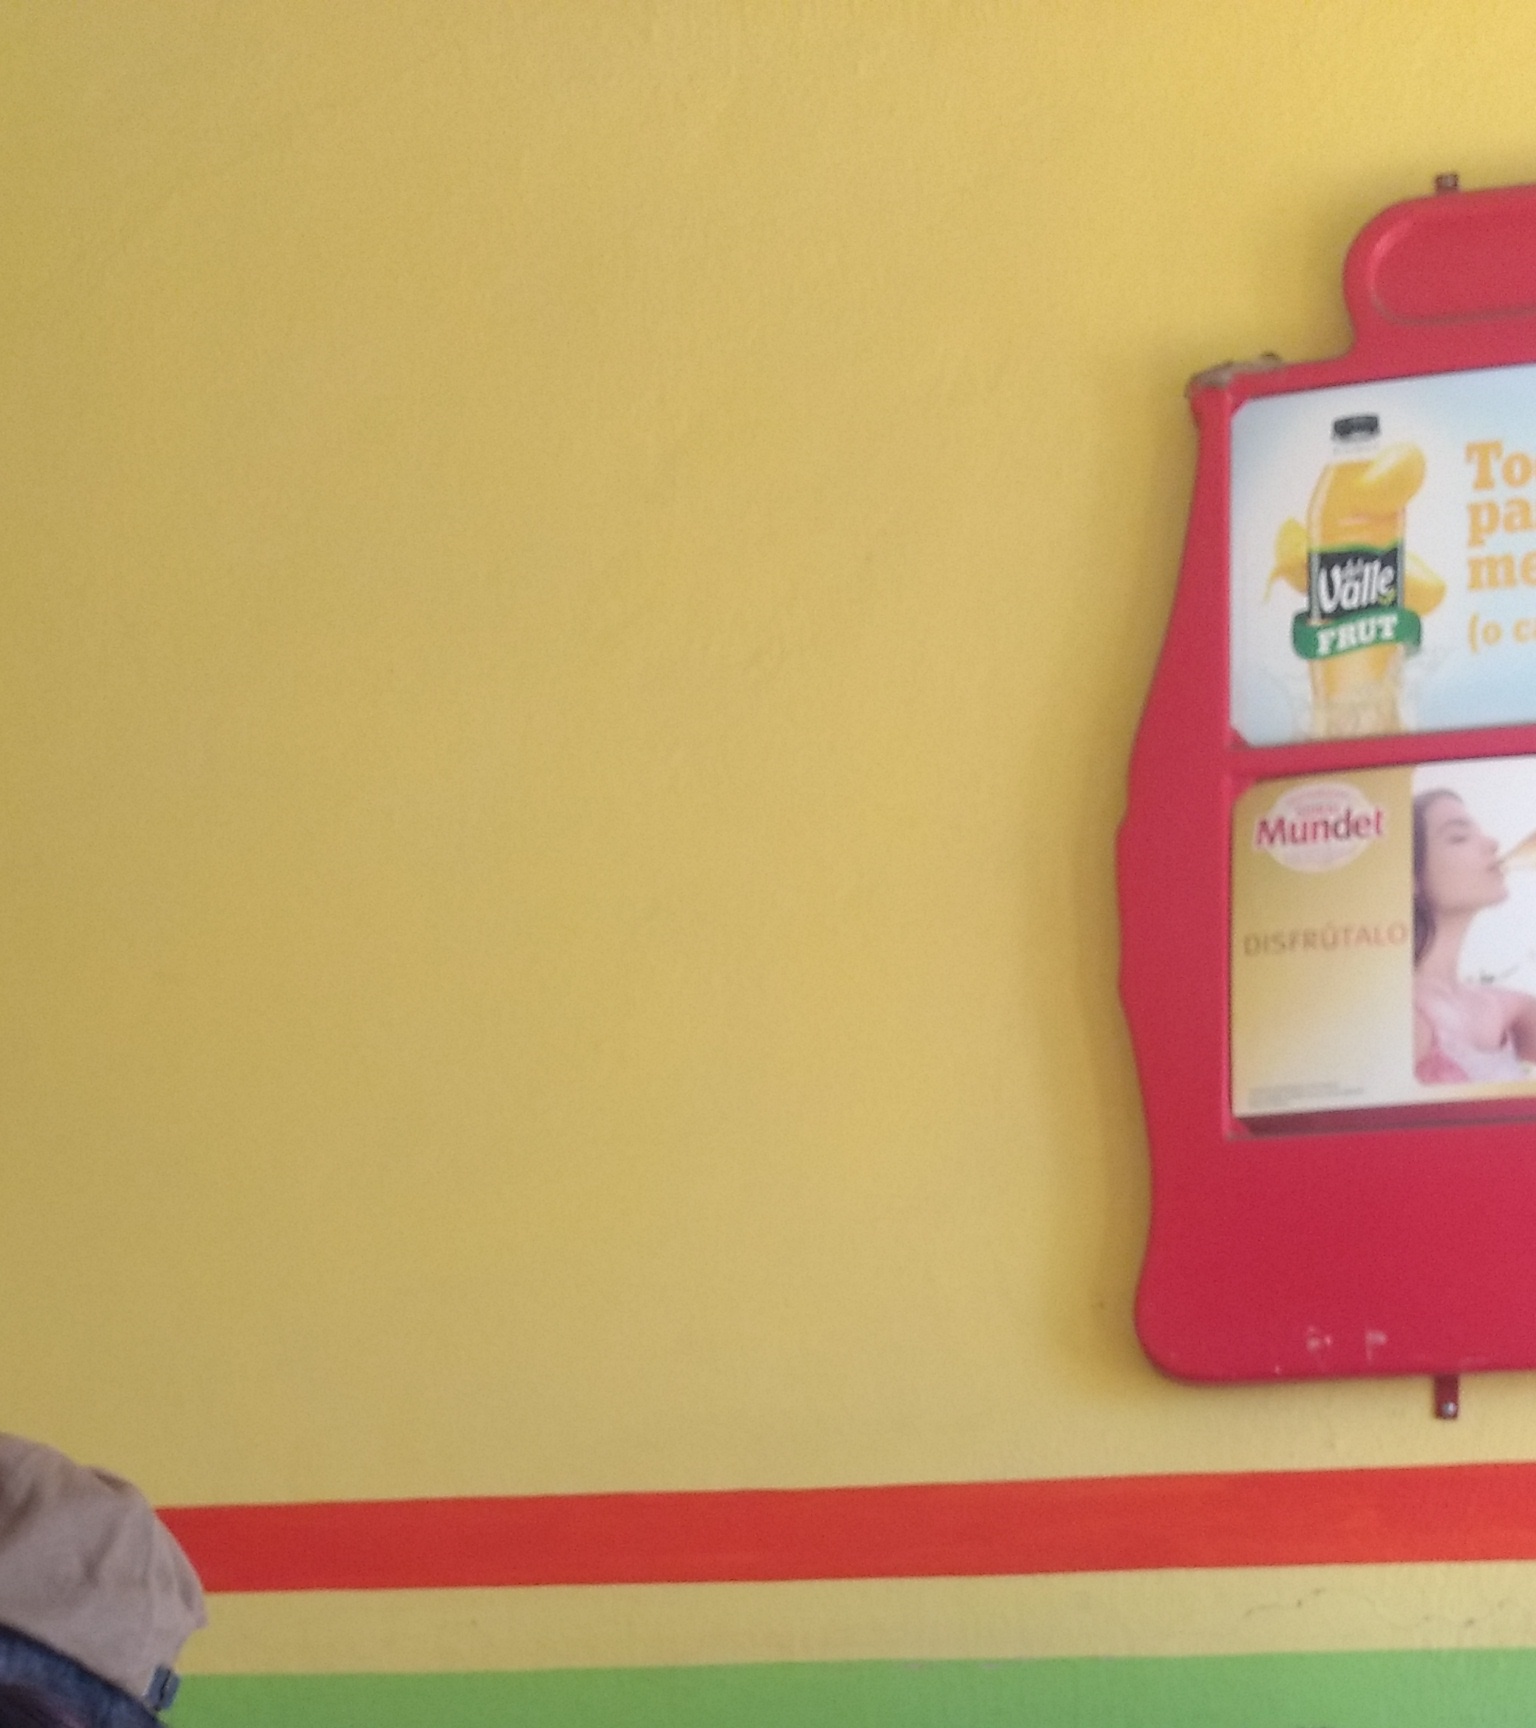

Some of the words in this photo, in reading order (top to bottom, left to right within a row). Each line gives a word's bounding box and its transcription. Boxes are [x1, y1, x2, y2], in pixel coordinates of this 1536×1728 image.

[1318, 558, 1396, 614] Valle
[1316, 613, 1398, 656] FRUT
[1469, 613, 1502, 652] (o
[1257, 807, 1384, 847] Mundet
